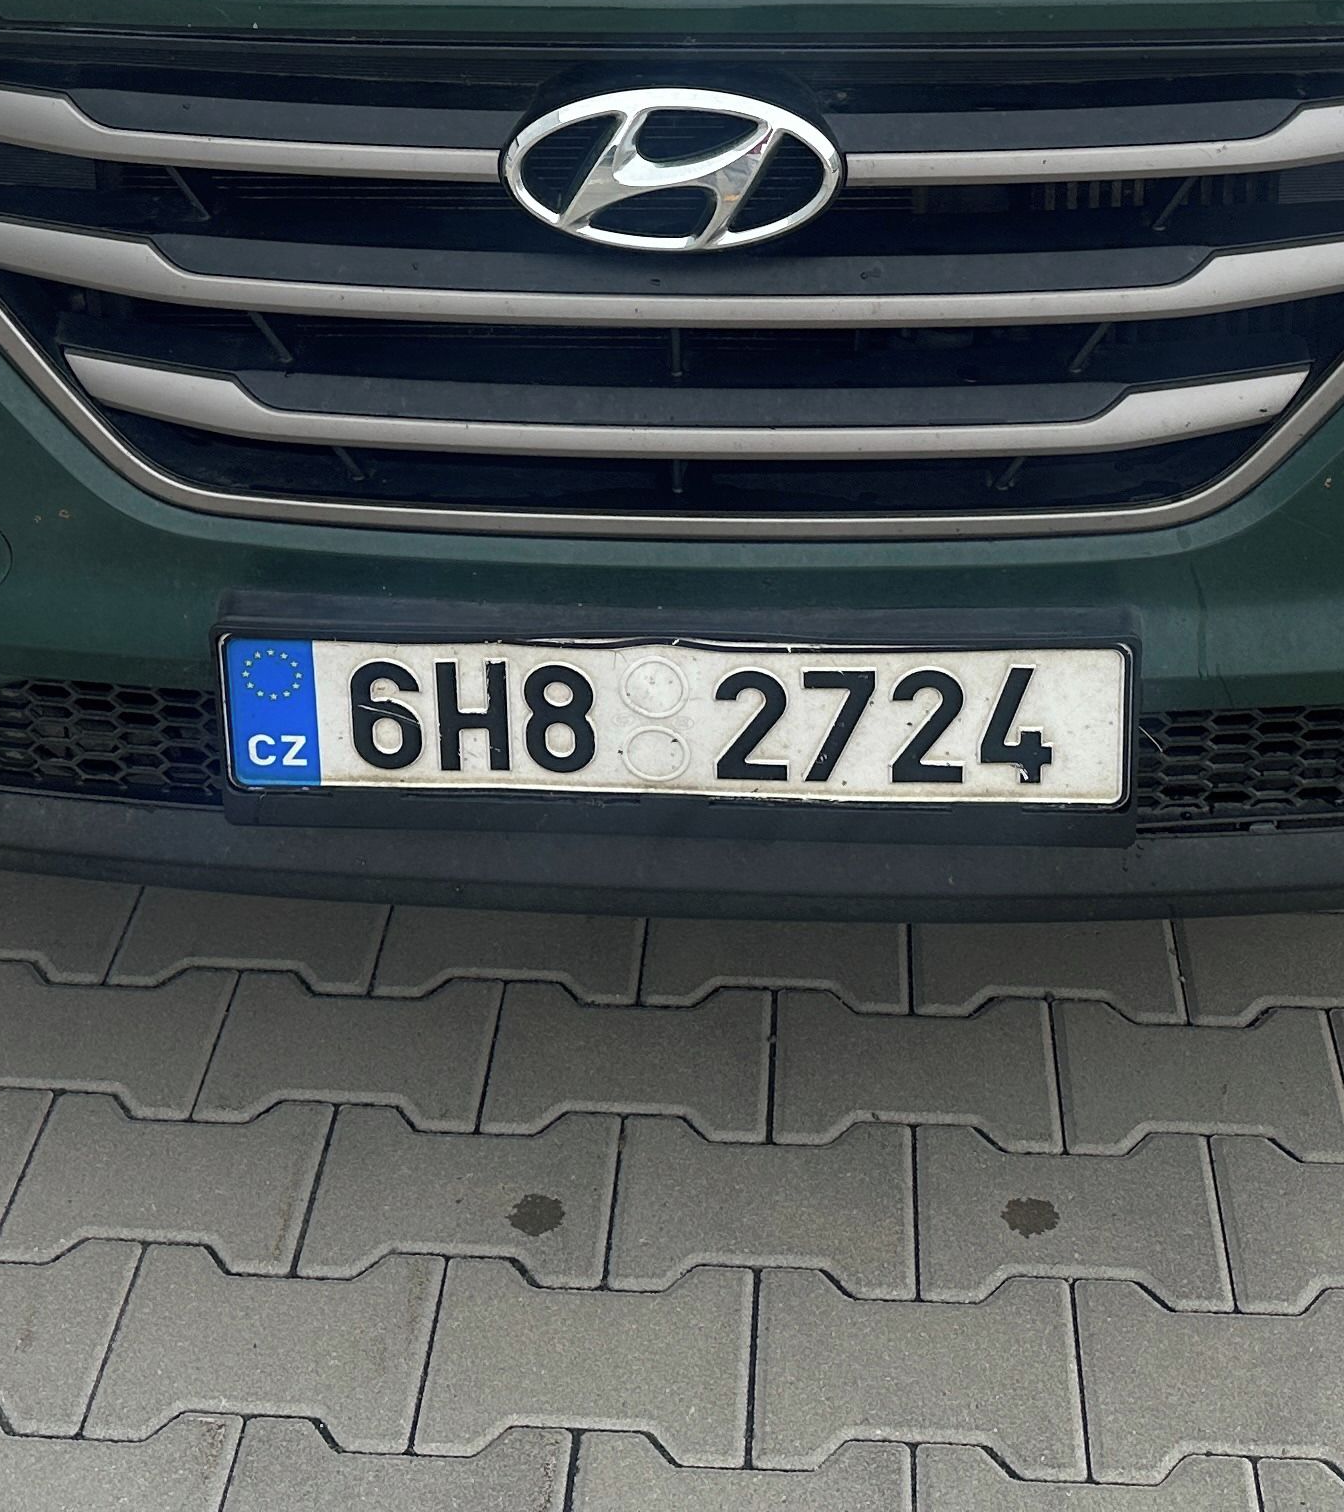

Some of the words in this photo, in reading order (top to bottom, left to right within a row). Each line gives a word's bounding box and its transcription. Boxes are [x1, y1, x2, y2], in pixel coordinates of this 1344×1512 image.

[248, 734, 308, 767] CZ
[349, 658, 597, 774] 6H8
[714, 666, 1053, 784] 2724
